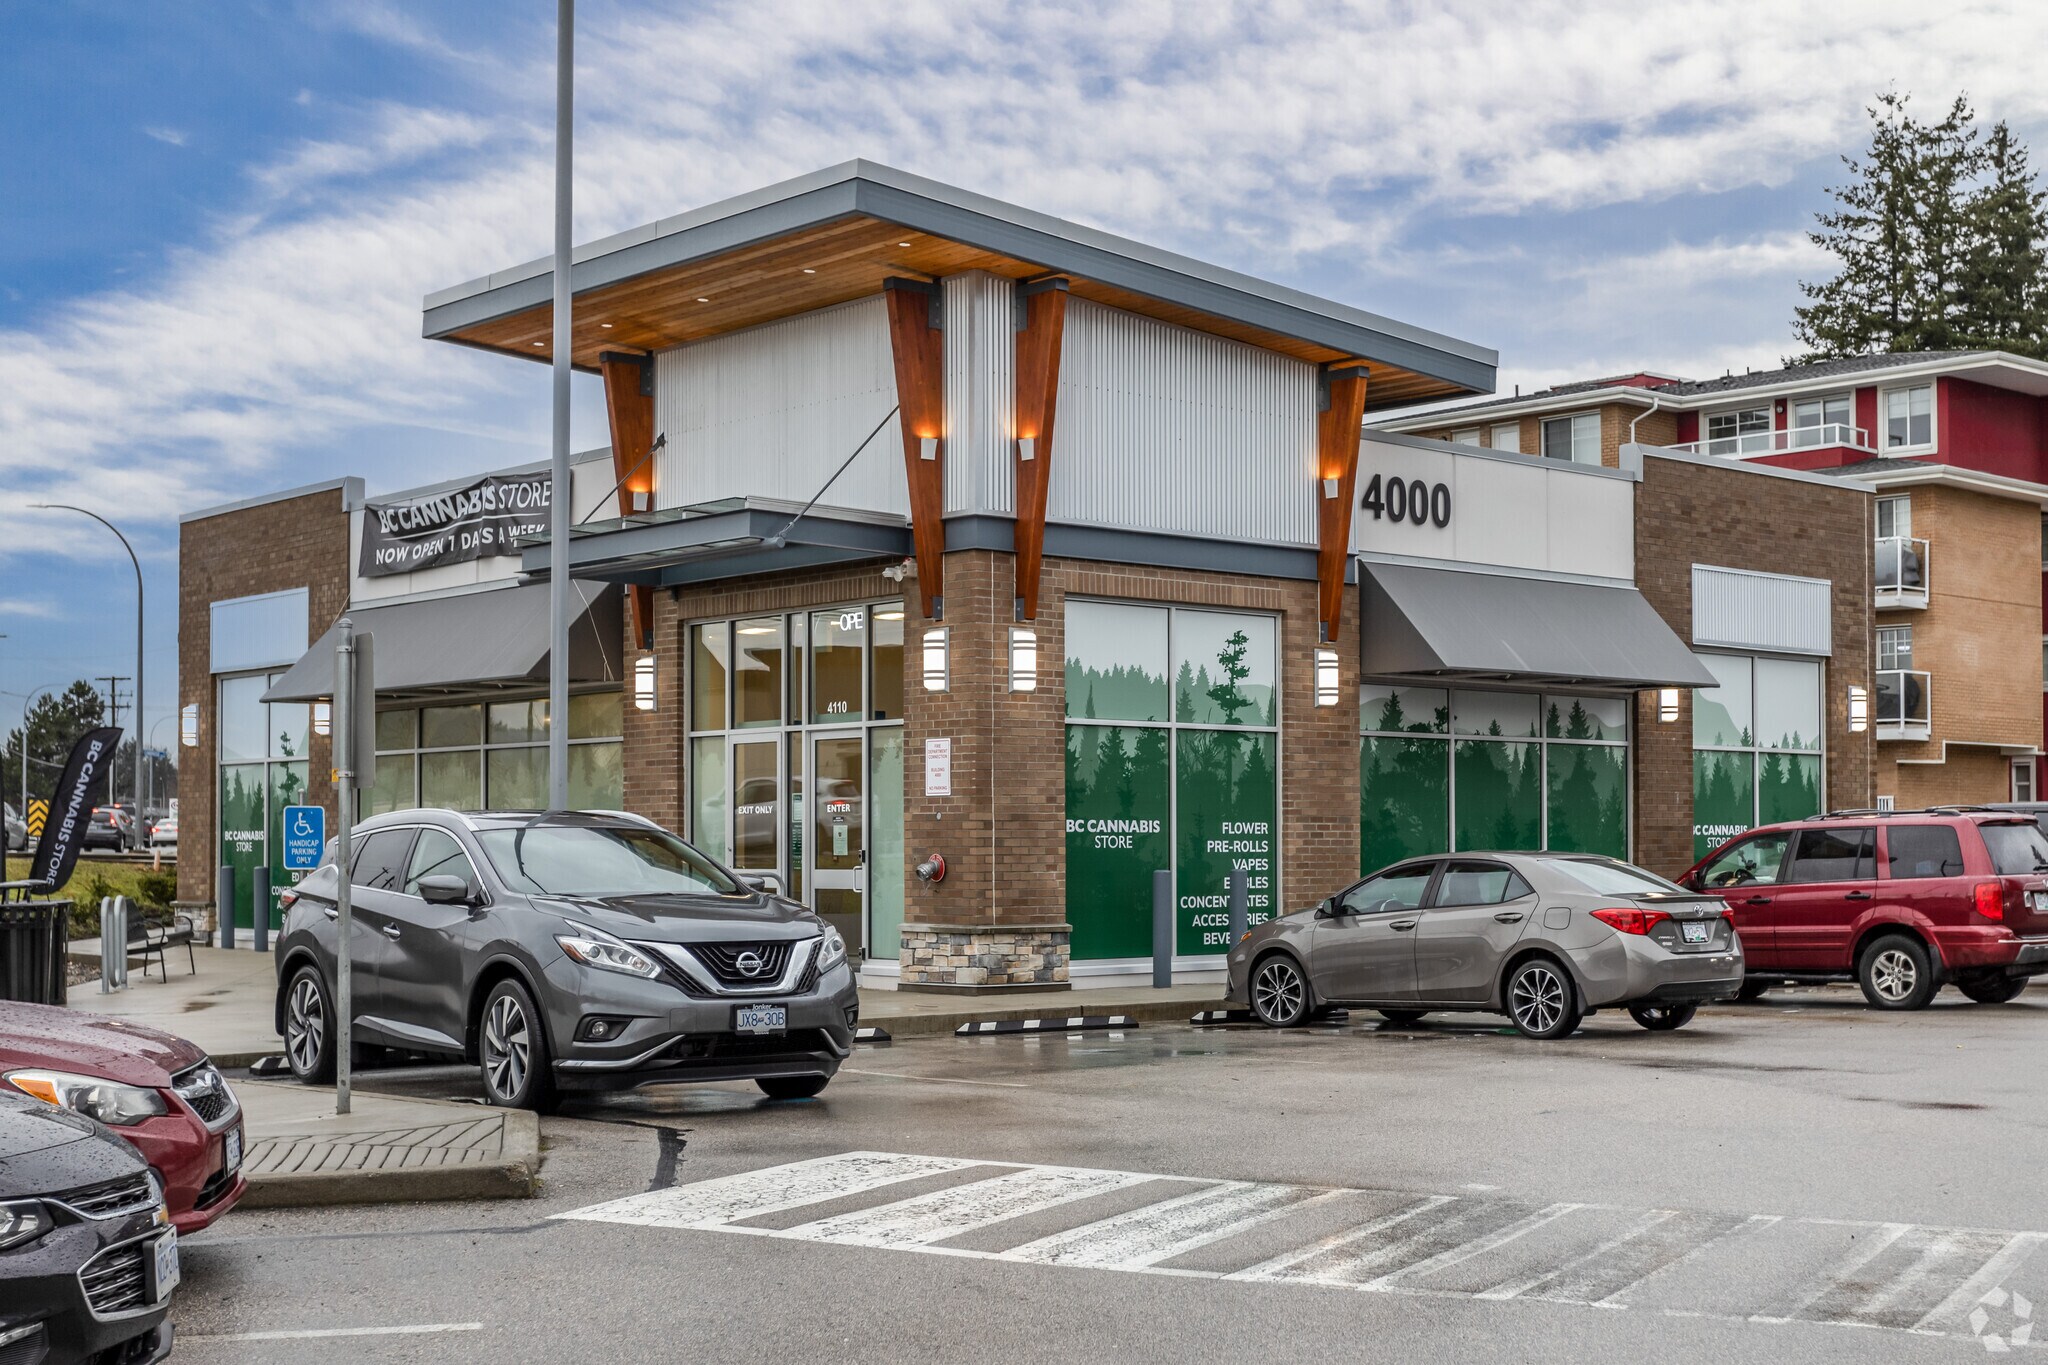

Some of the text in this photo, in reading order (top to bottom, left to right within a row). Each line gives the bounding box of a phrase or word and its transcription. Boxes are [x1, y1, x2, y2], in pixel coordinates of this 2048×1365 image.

[377, 481, 552, 533] BC CANNABIS STORE
[1361, 473, 1451, 528] 4000
[376, 545, 410, 565] NOW
[412, 537, 444, 560] OPEN
[448, 535, 455, 552] 7
[461, 527, 494, 550] DAS
[498, 526, 505, 544] A
[839, 611, 863, 632] OPE
[827, 700, 847, 714] 4110
[46, 739, 103, 887] BC CANNABIS STORE
[738, 805, 773, 814] EXIT ONLY
[826, 803, 851, 813] ENTER
[1066, 819, 1161, 833] BC CANNABIS
[1222, 822, 1268, 835] FLOWER
[1702, 824, 1748, 836] CANNABIS
[224, 830, 264, 841] BC CANNABIS
[1094, 835, 1133, 849] STORE
[236, 841, 253, 852] STORE
[289, 839, 320, 847] HANDICAP
[1207, 840, 1269, 853] PRE-ROLLS
[291, 848, 317, 856] PARKING
[296, 856, 312, 864] ONLY
[1232, 858, 1269, 871] VAPES
[1191, 912, 1269, 927] ACCESRIES
[738, 1011, 785, 1028] JX8 30B
